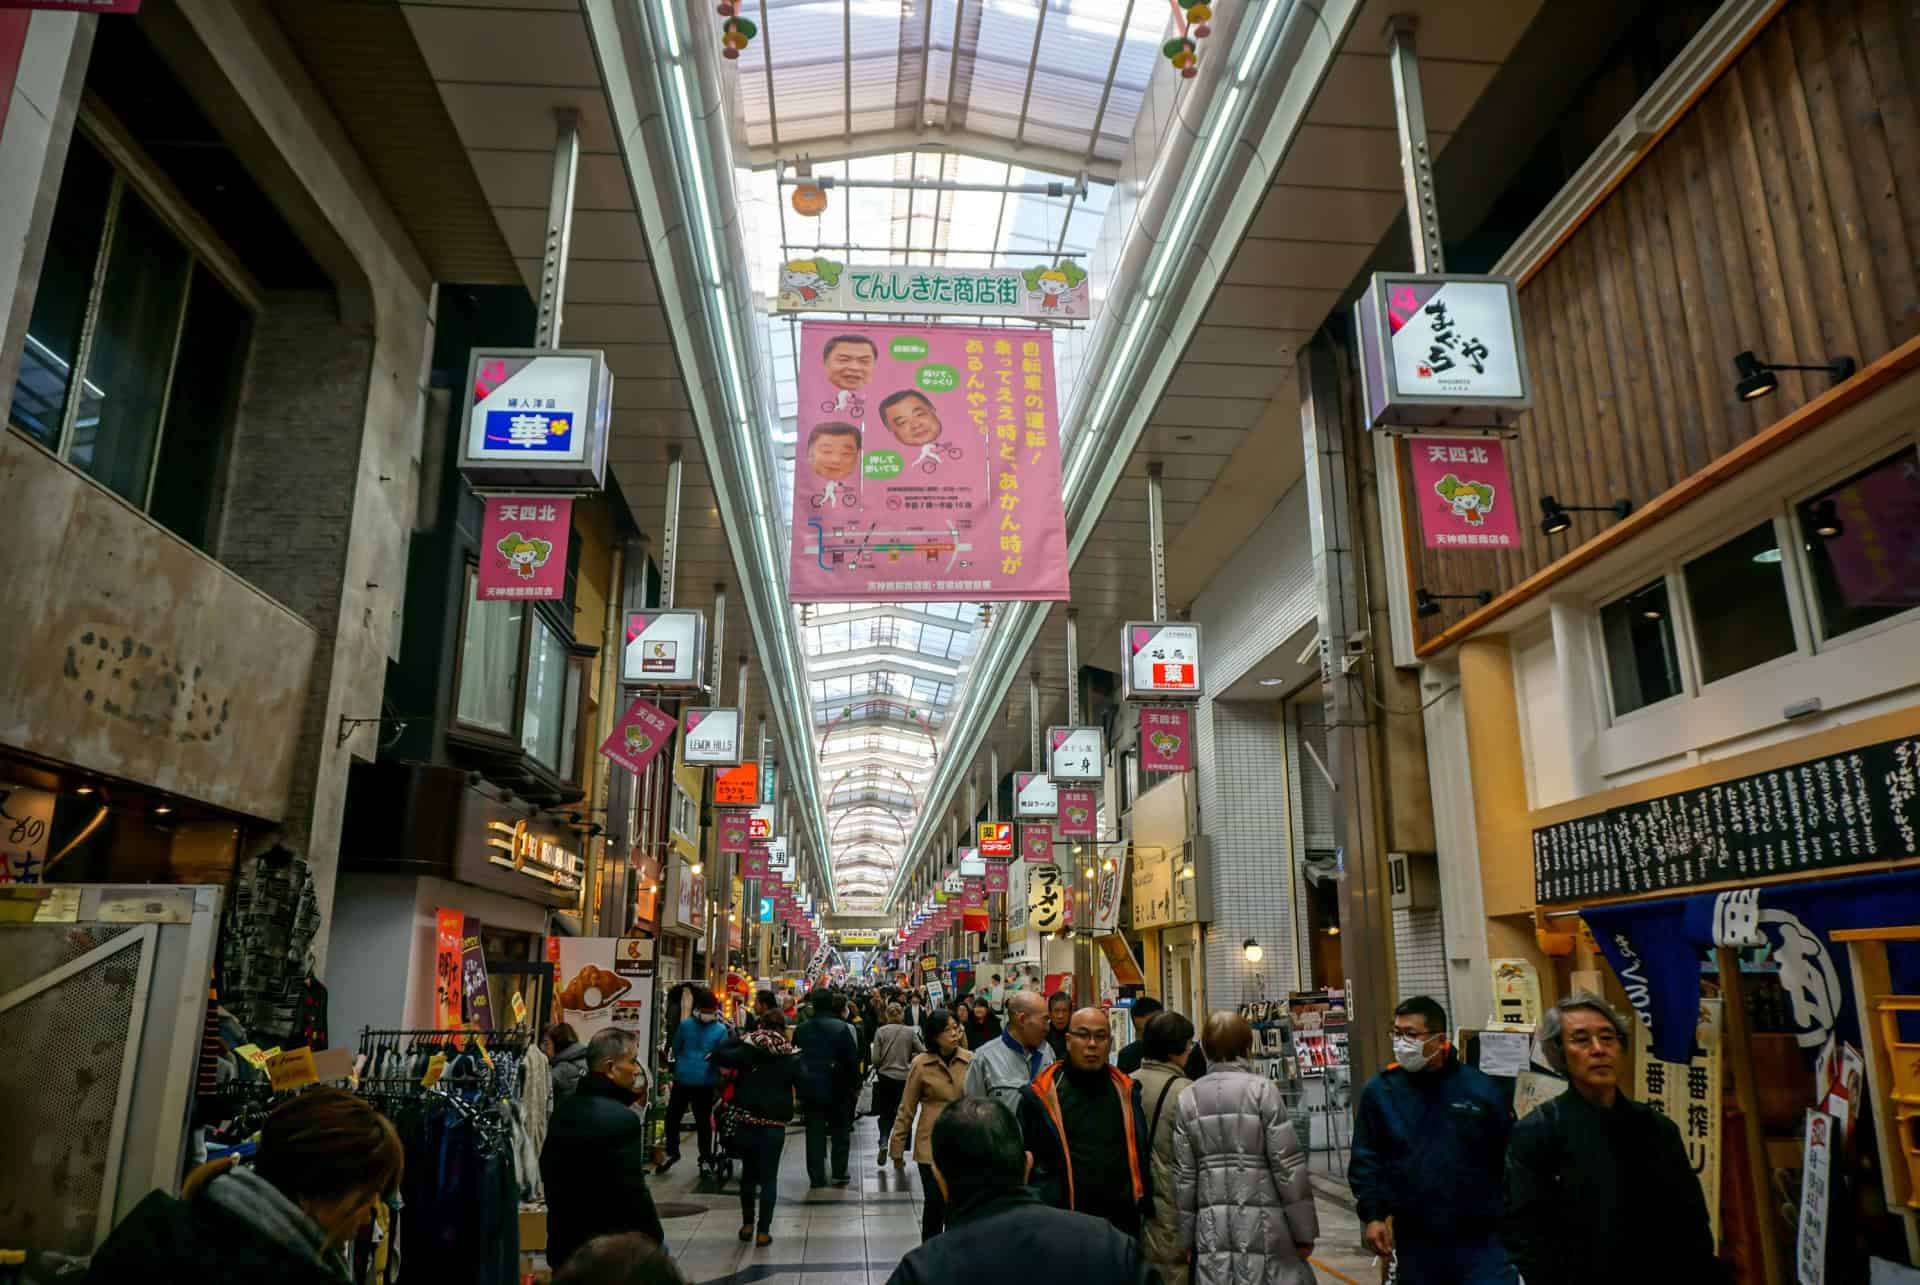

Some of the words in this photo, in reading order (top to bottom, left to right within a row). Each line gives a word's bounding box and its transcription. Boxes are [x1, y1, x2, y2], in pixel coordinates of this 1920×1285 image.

[851, 274, 1018, 305] てんしきた商店街
[508, 413, 550, 449] 華
[1427, 445, 1489, 464] 天四北
[499, 504, 557, 522] 天四北
[1149, 714, 1181, 725] 天四北
[1037, 866, 1058, 927] ラーメン
